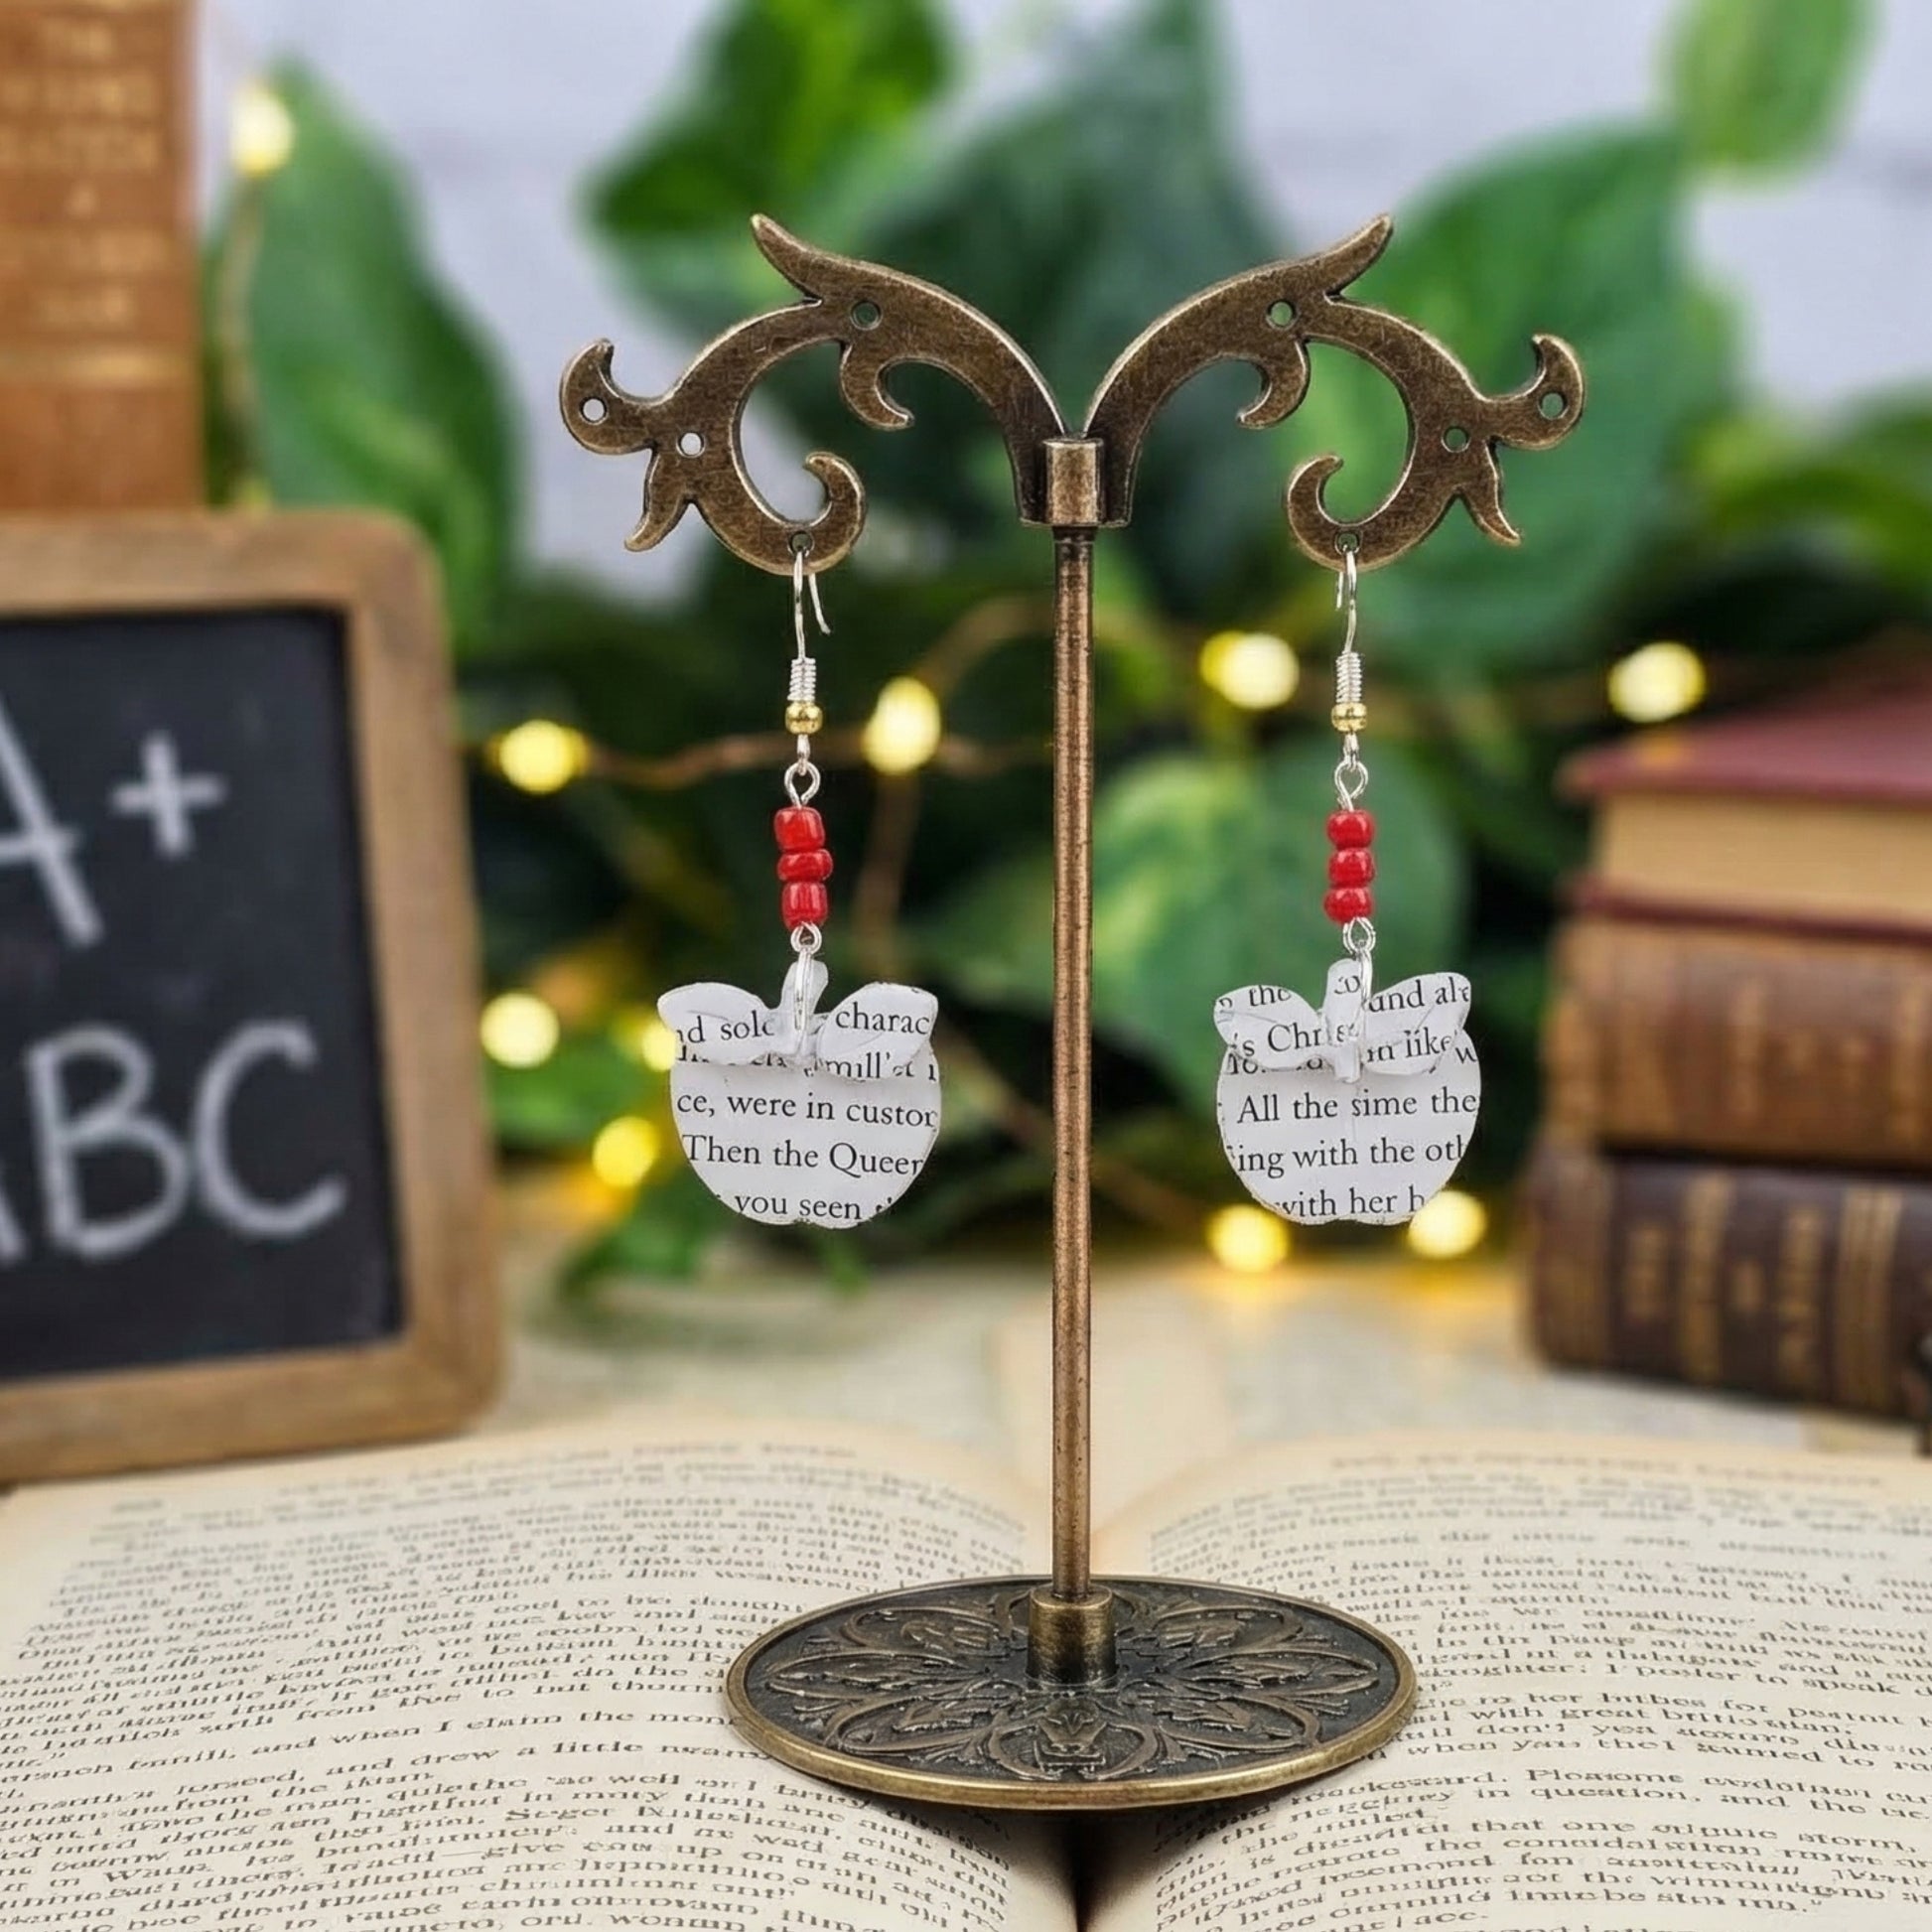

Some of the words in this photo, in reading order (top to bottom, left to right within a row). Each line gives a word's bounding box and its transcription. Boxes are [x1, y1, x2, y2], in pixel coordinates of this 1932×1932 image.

[835, 1001, 930, 1035] charac
[677, 1093, 716, 1117] ce,
[727, 1096, 796, 1116] were
[806, 1092, 834, 1120] in
[1237, 1092, 1281, 1124] All
[1293, 1091, 1338, 1120] the
[1351, 1088, 1418, 1118] sime
[1431, 1085, 1477, 1114] the
[682, 1134, 761, 1165] Then
[773, 1140, 819, 1168] the
[1293, 1138, 1358, 1169] with
[1370, 1136, 1419, 1164] the
[799, 1199, 863, 1220] seen
[1349, 1186, 1398, 1214] her
